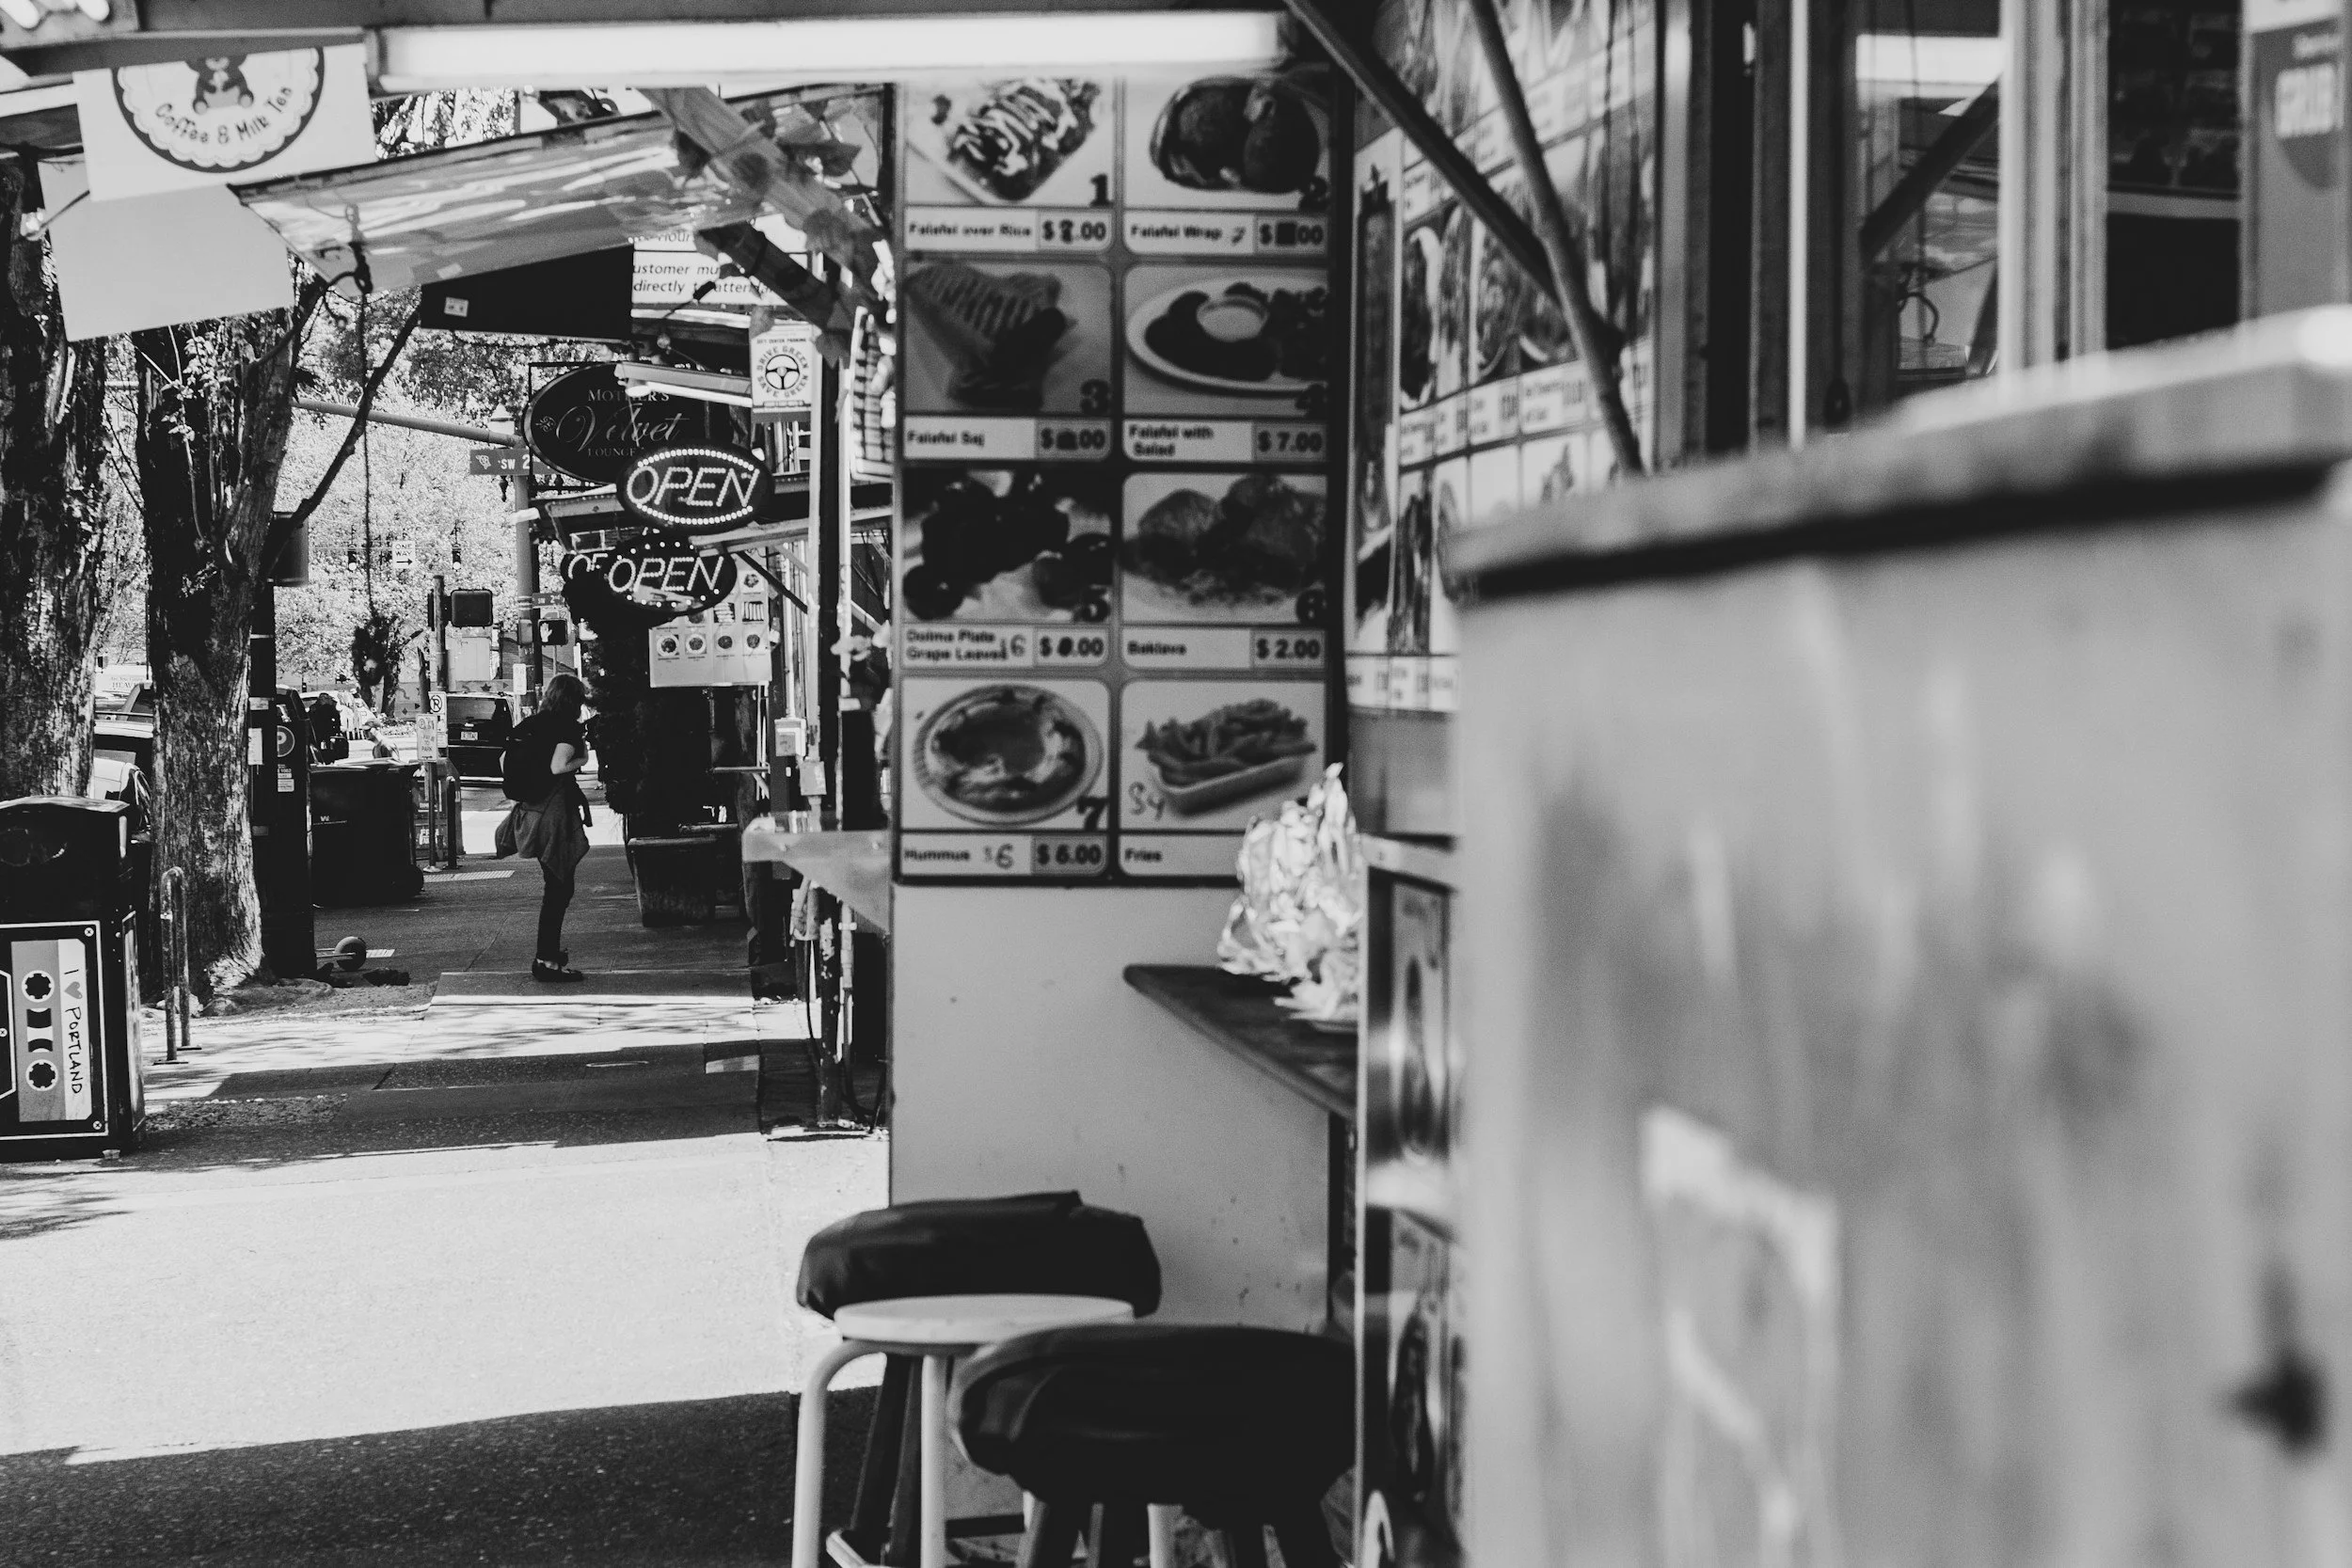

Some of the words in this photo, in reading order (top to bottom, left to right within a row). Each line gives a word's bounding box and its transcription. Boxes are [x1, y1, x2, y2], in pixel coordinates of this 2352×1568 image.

[156, 103, 209, 143] Coffee
[236, 115, 270, 141] Milk
[266, 87, 293, 113] Tea
[1089, 174, 1114, 208] 1
[909, 222, 958, 235] Falafel
[1131, 225, 1180, 239] Falafel
[633, 264, 690, 276] ustomer
[634, 280, 685, 293] directly
[907, 430, 957, 445] Falafel
[1129, 424, 1179, 439] Falafel
[501, 458, 516, 469] SW
[627, 466, 760, 508] OPEN
[609, 557, 723, 593] OPEN
[958, 629, 996, 643] Plate
[1077, 797, 1108, 830] 7
[904, 849, 971, 862] Hummus
[1125, 847, 1163, 863] Fries
[65, 1006, 83, 1094] PORTLAND
